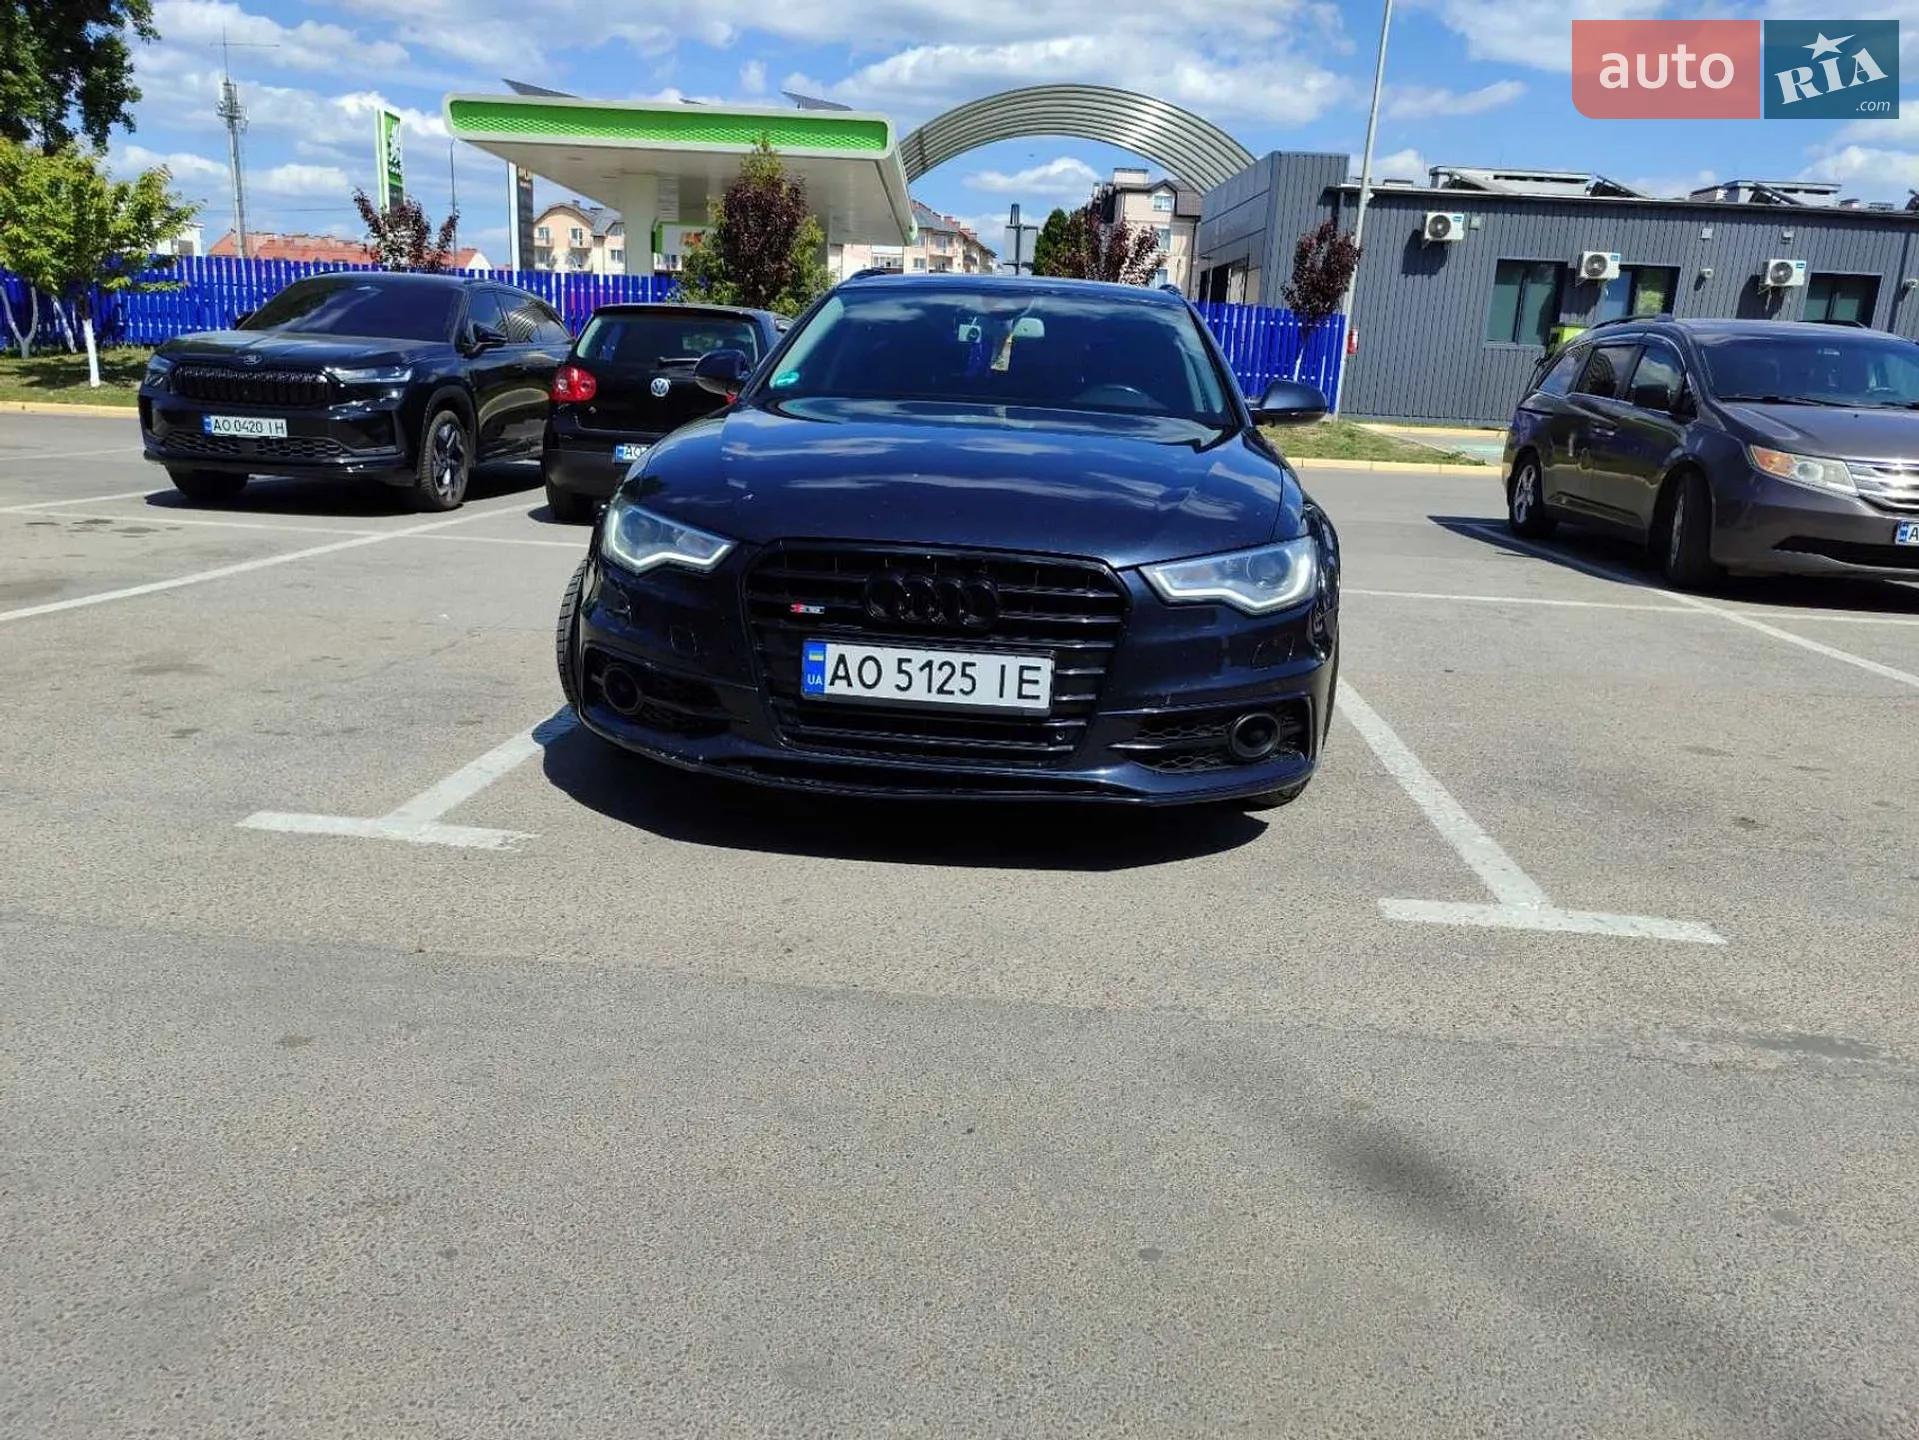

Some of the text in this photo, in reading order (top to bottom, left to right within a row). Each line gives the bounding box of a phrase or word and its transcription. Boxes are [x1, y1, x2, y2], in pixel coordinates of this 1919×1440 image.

[213, 419, 285, 435] AO 0420 IH
[807, 675, 823, 686] UA
[829, 653, 1042, 700] AO 5125 IE
